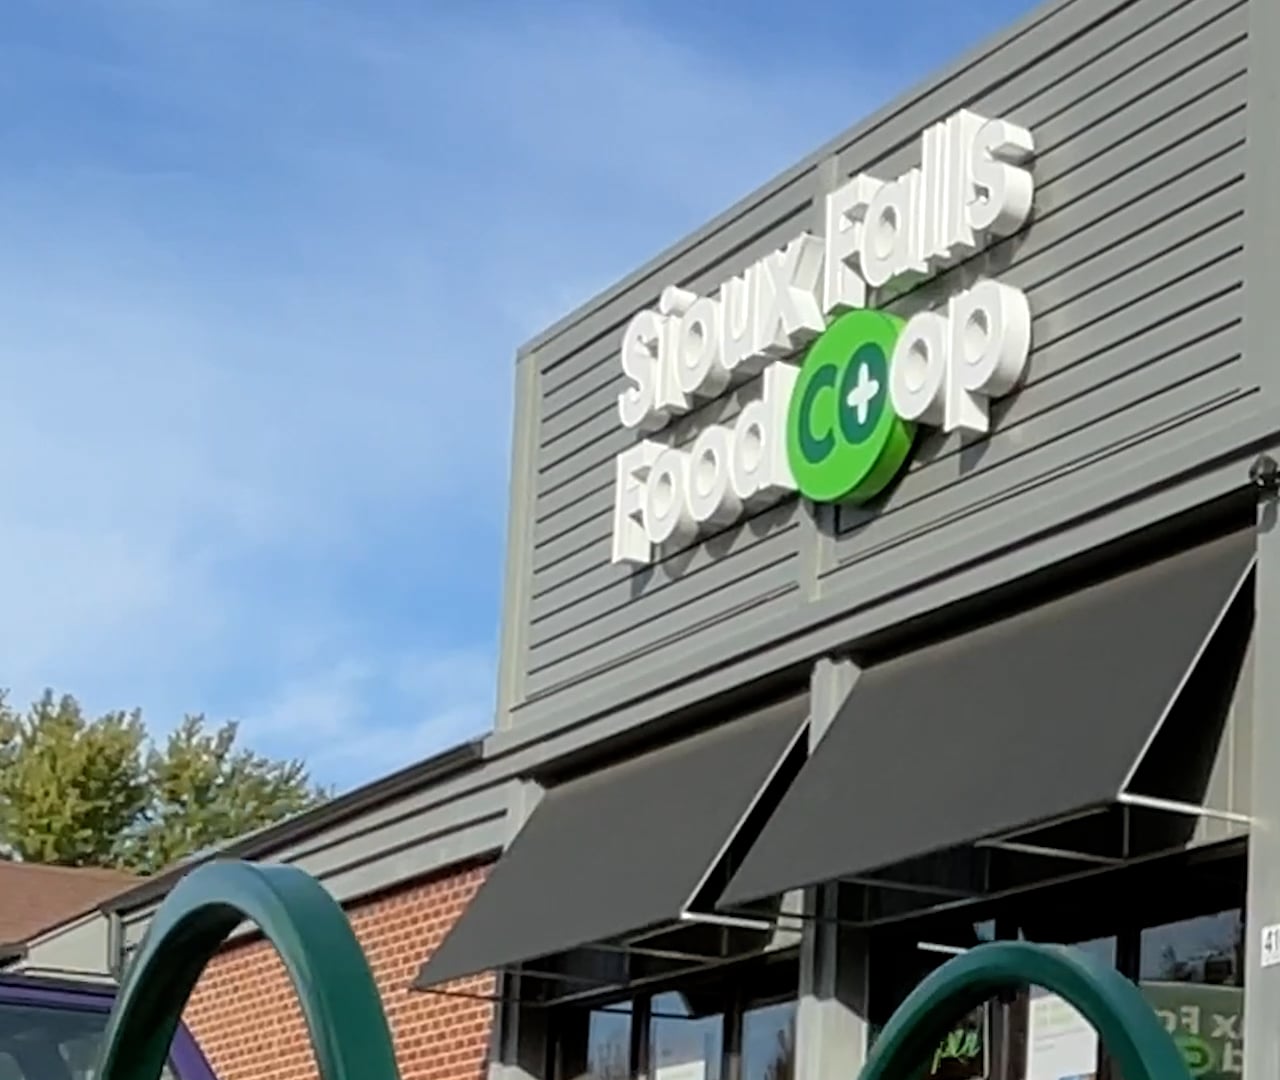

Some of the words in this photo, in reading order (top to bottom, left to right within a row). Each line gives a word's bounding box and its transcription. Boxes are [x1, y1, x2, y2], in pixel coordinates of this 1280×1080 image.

[619, 232, 825, 429] Sioux
[824, 108, 1034, 313] Falls
[612, 361, 800, 564] Food
